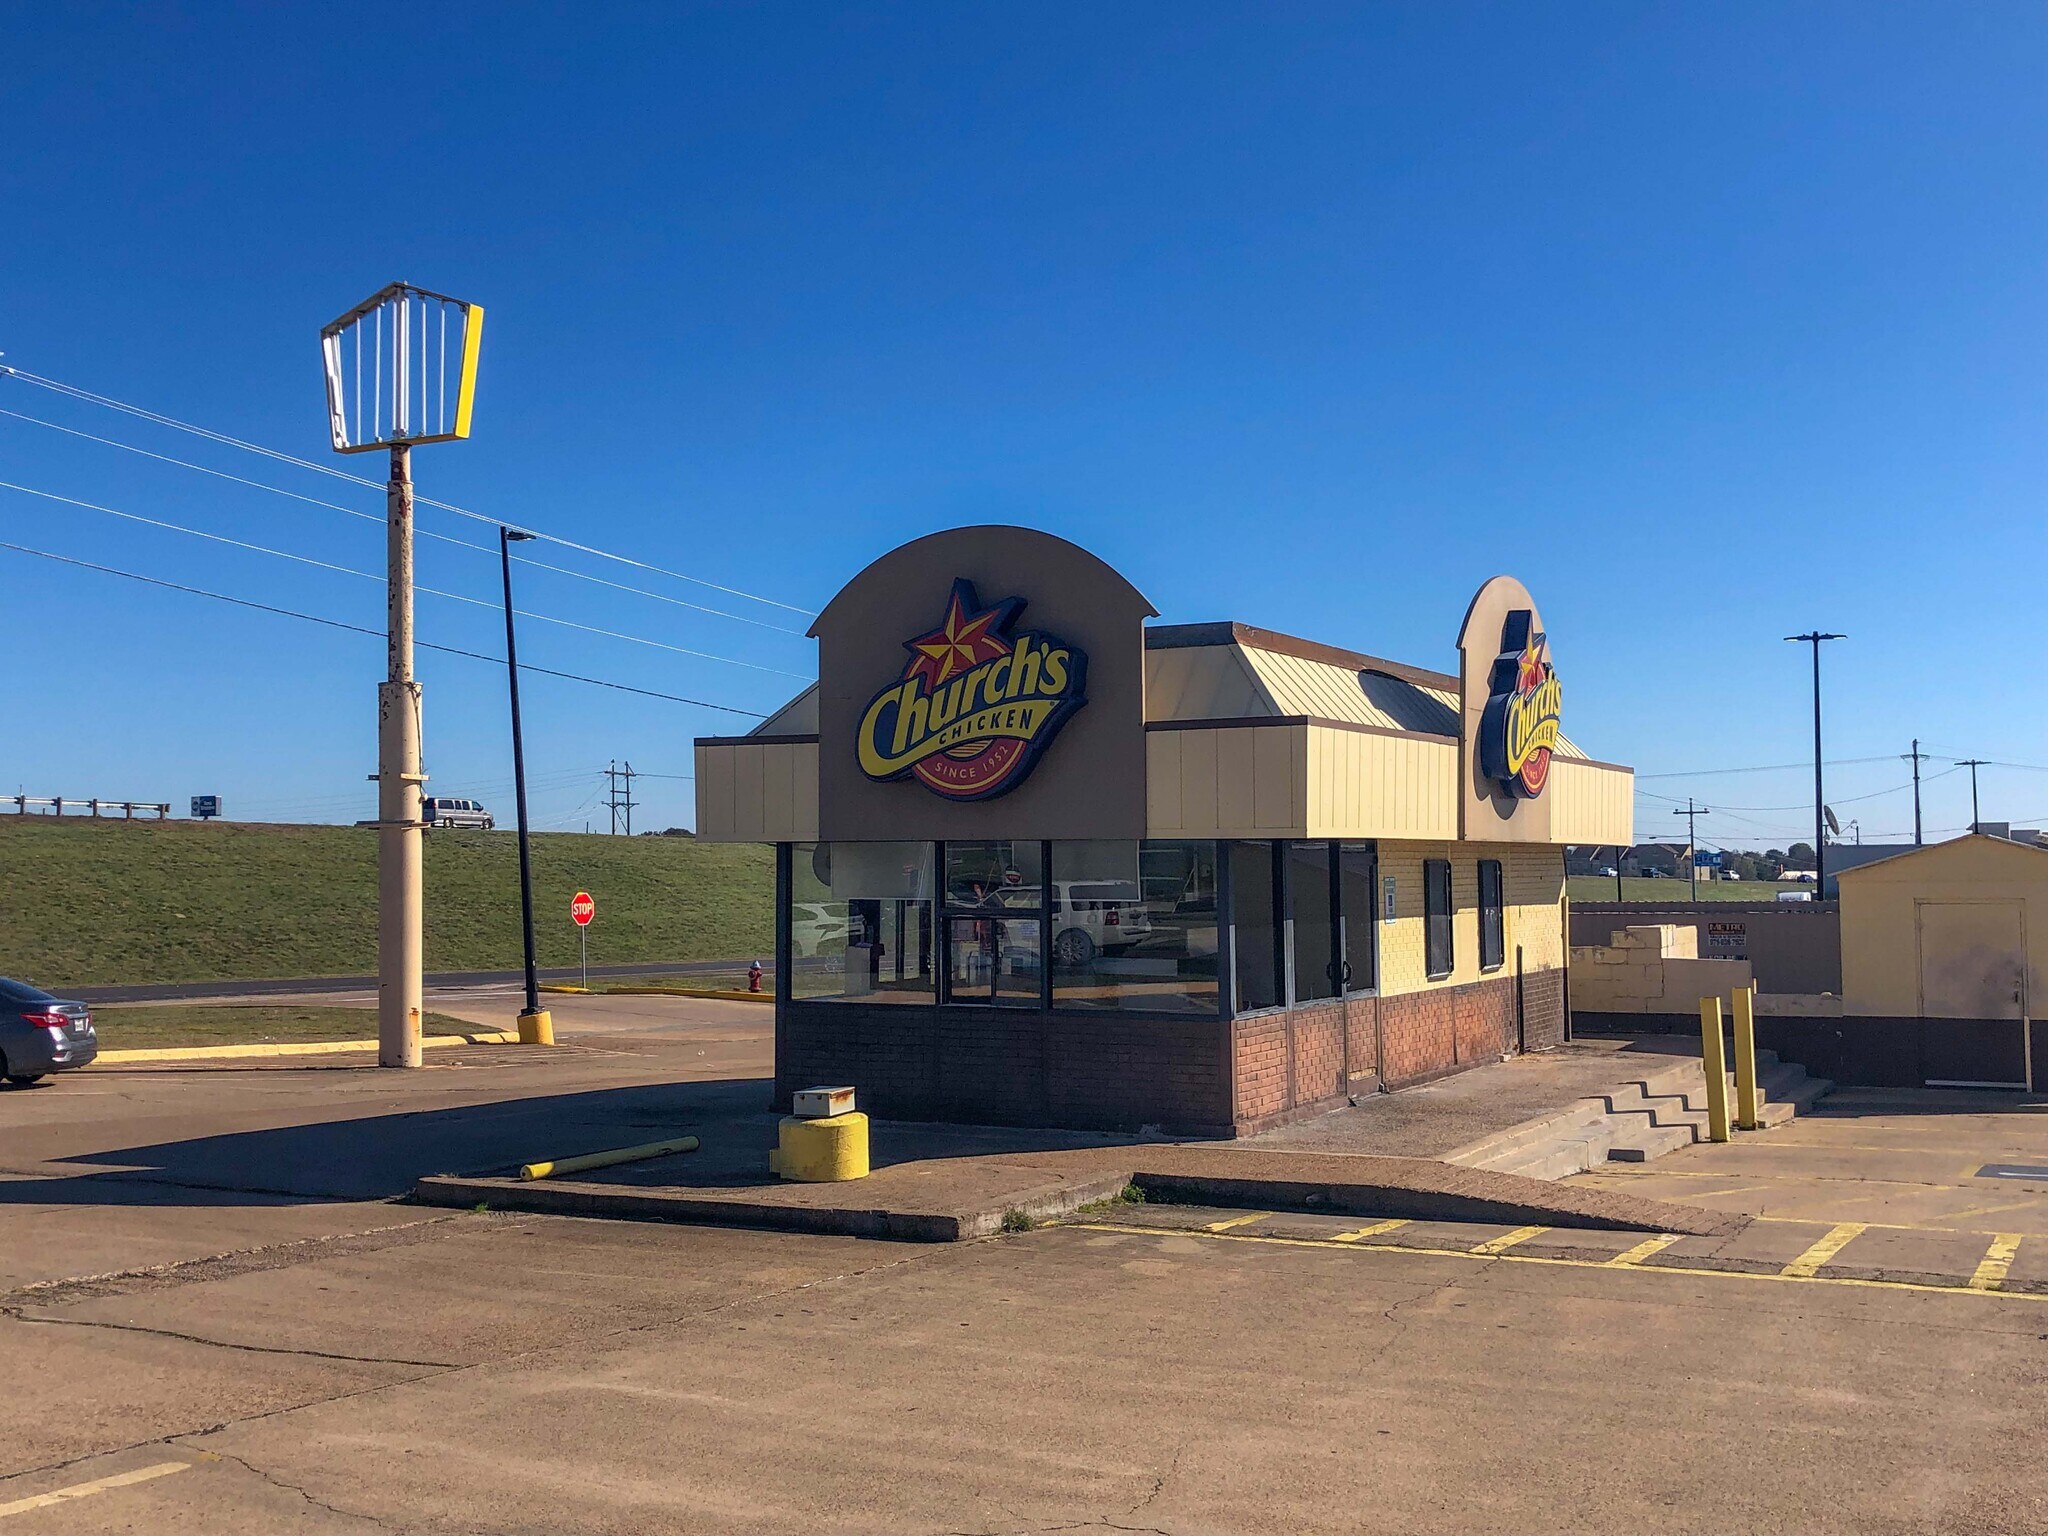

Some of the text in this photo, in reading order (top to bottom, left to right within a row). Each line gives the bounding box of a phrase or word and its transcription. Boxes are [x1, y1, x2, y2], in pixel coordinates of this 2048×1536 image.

[858, 636, 1069, 776] Church's
[1508, 669, 1562, 775] Church's
[938, 708, 1033, 745] CHICKEN
[1528, 725, 1554, 750] CHICKEN
[935, 746, 1009, 779] SINCE 1952
[573, 903, 592, 915] STOP
[1709, 923, 1744, 931] METRO
